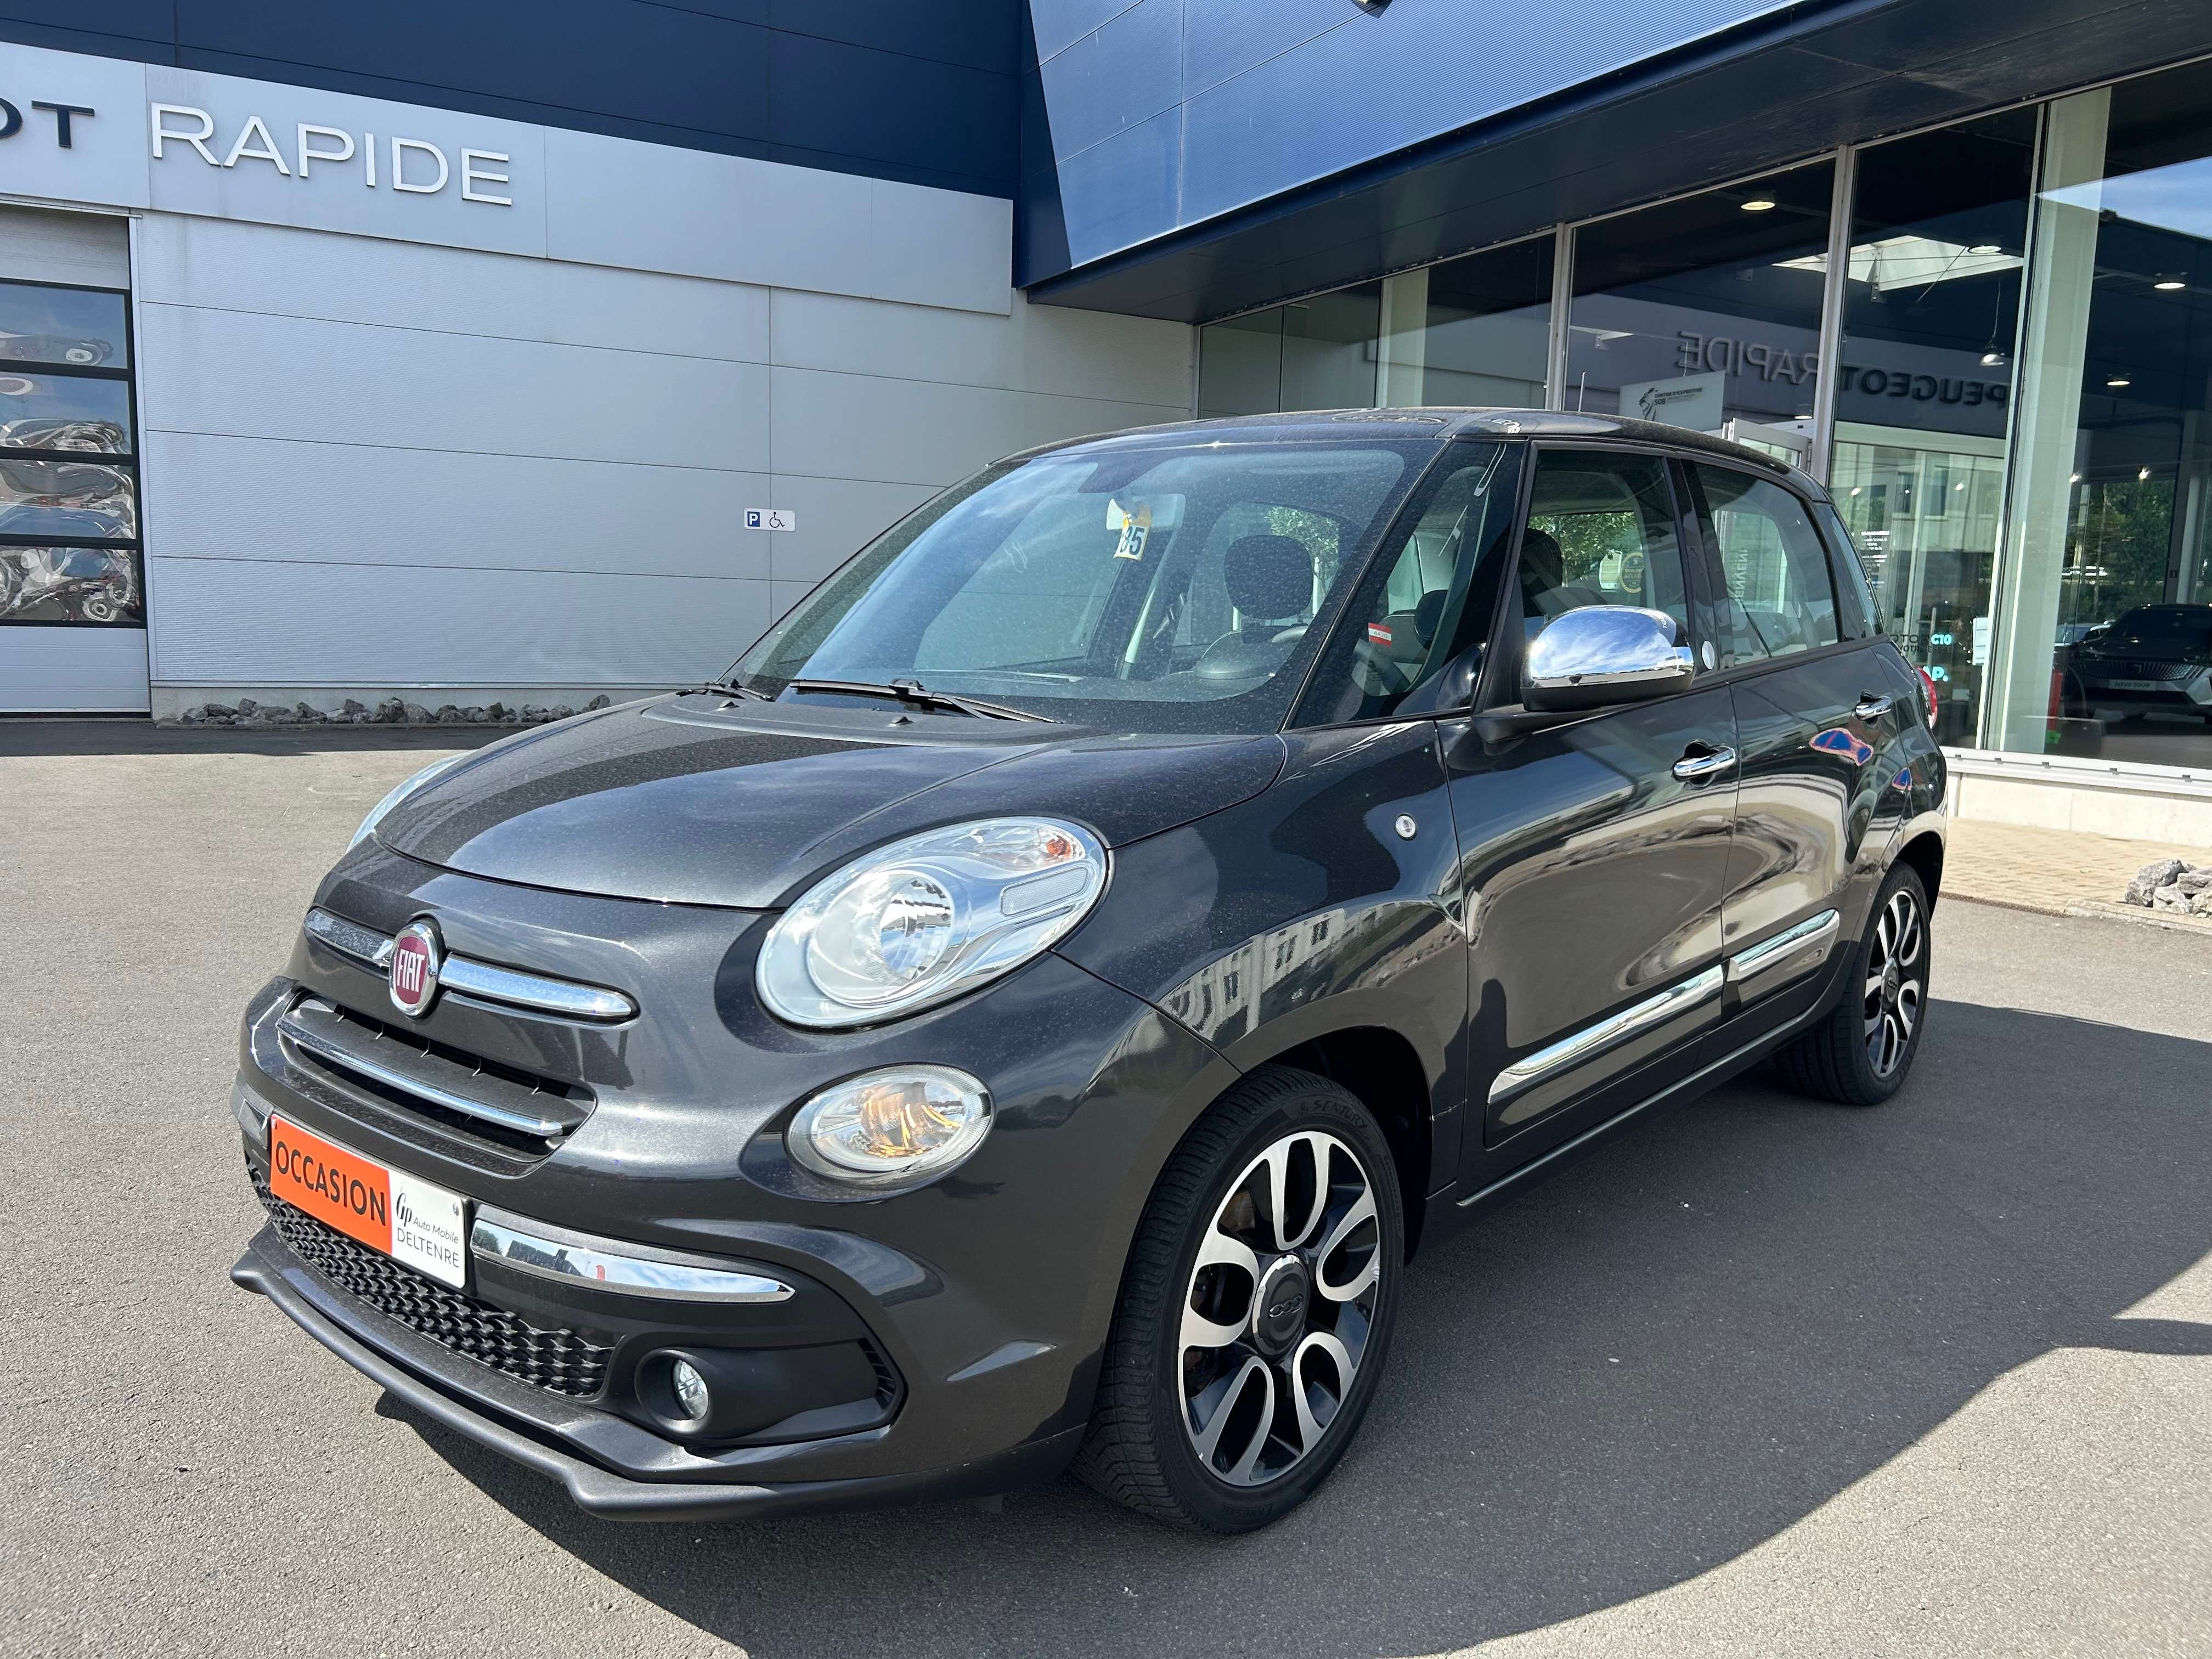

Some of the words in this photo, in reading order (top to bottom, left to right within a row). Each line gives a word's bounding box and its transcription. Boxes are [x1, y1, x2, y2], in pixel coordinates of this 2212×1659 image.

[150, 101, 512, 206] RAPIDE
[749, 513, 758, 525] P
[1931, 634, 1952, 645] C10
[397, 949, 426, 992] FIAT
[275, 1141, 386, 1226] OCCASION
[397, 1227, 460, 1269] DELTENRE
[413, 1216, 431, 1232] Auto
[432, 1226, 459, 1244] Mobile
